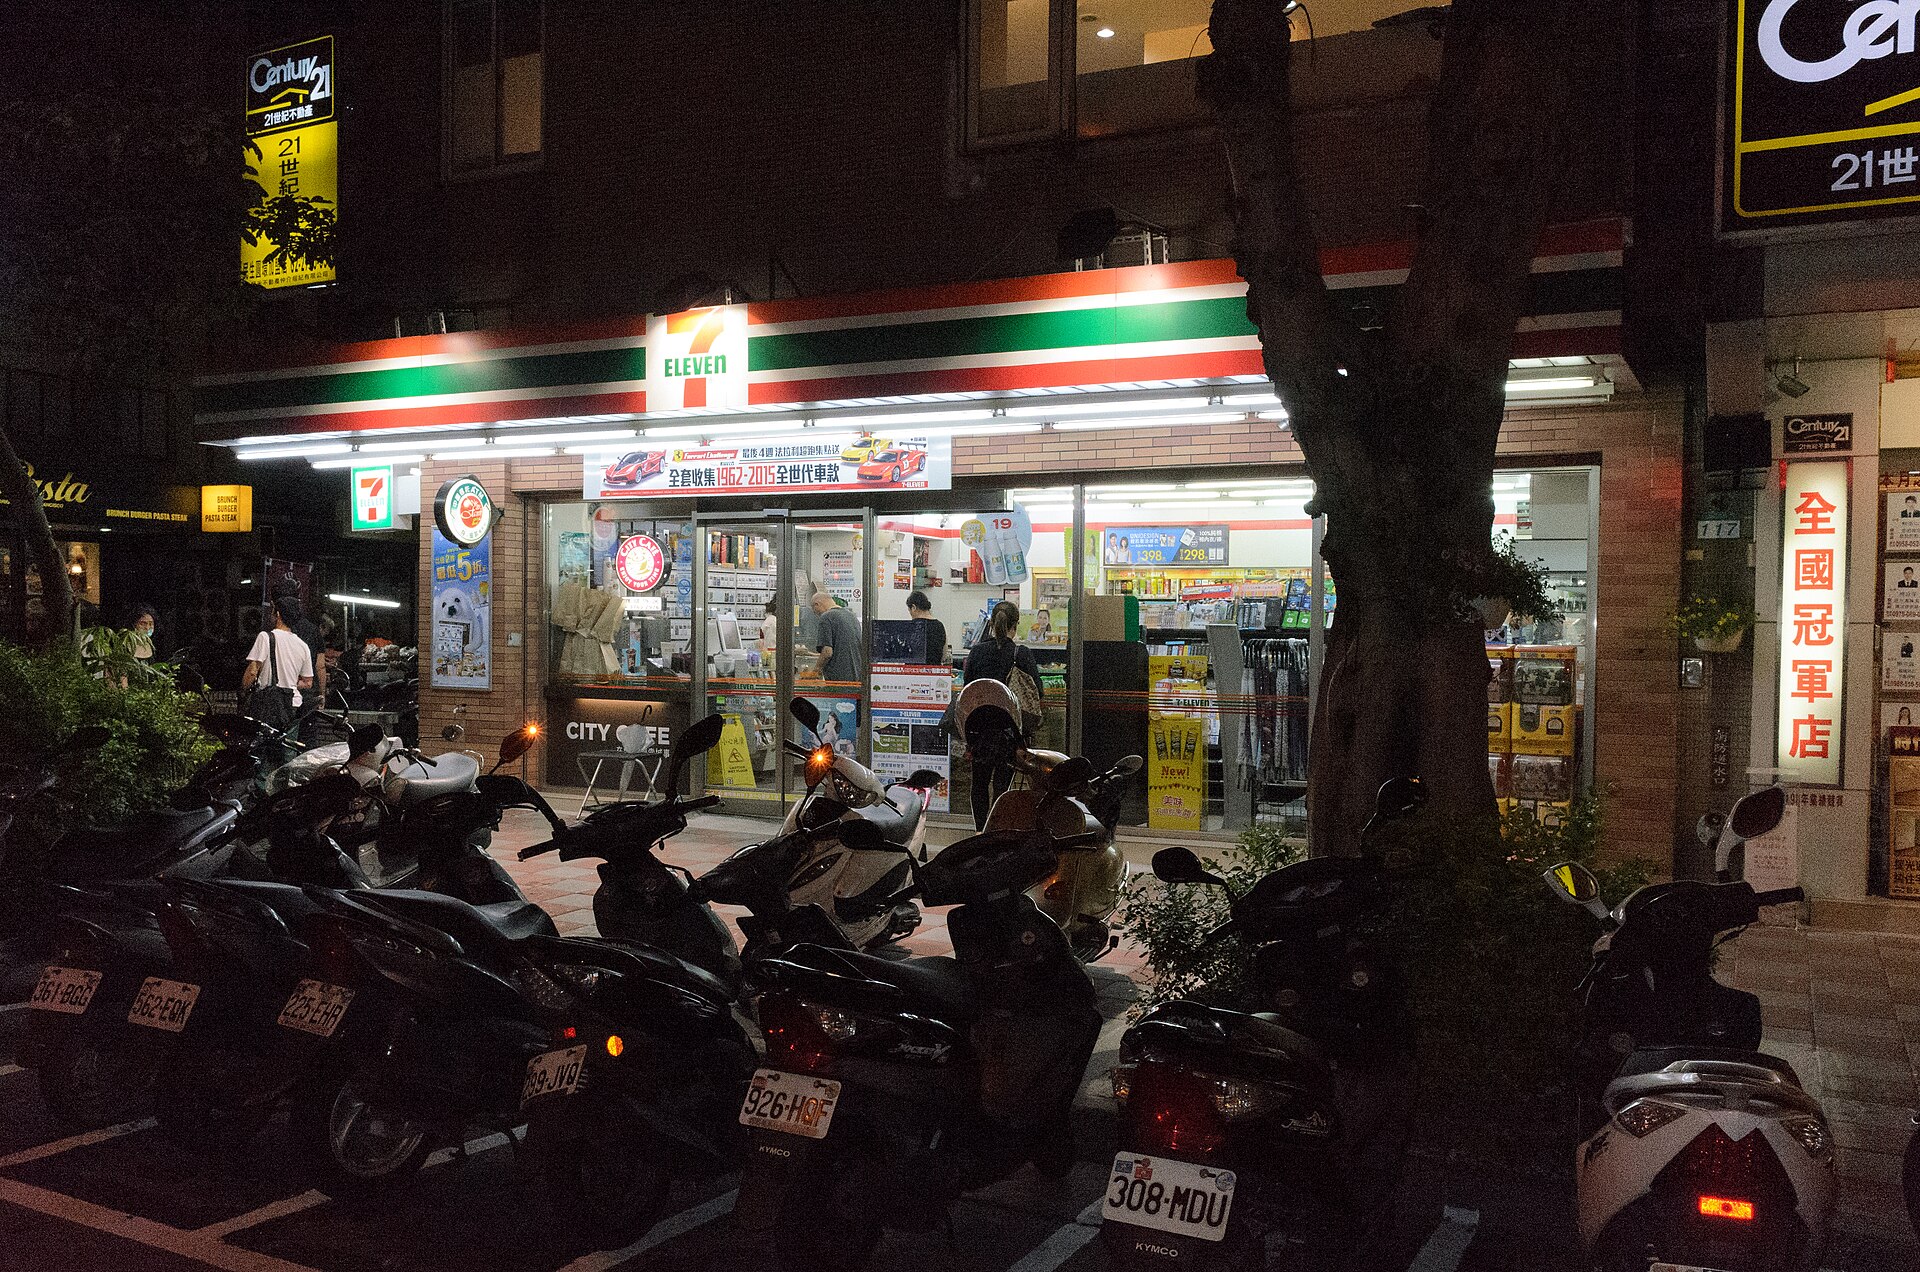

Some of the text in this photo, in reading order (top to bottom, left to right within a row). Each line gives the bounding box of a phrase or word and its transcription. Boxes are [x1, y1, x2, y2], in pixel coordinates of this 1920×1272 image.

[250, 56, 331, 101] Century 21
[264, 104, 313, 126] 21世紀不動產
[1831, 147, 1919, 191] 21世
[1788, 418, 1849, 441] Century 21
[106, 509, 129, 517] BRUNCH
[131, 511, 152, 519] BURGER
[153, 512, 170, 520] PASTA
[221, 514, 237, 522] STEAK
[993, 518, 1012, 529] 19
[1701, 522, 1737, 536] 117
[620, 539, 637, 557] CITY
[1142, 550, 1162, 561] 398
[1184, 549, 1204, 560] 298
[620, 567, 632, 584] ENJOY
[648, 567, 660, 583] TIME
[1788, 492, 1837, 759] 全國冠軍店
[566, 721, 611, 741] CITY
[1161, 766, 1190, 779] New!
[759, 1146, 790, 1157] KYMCO
[1109, 1175, 1228, 1227] 308-MDU
[1135, 1242, 1178, 1257] KYMCO
